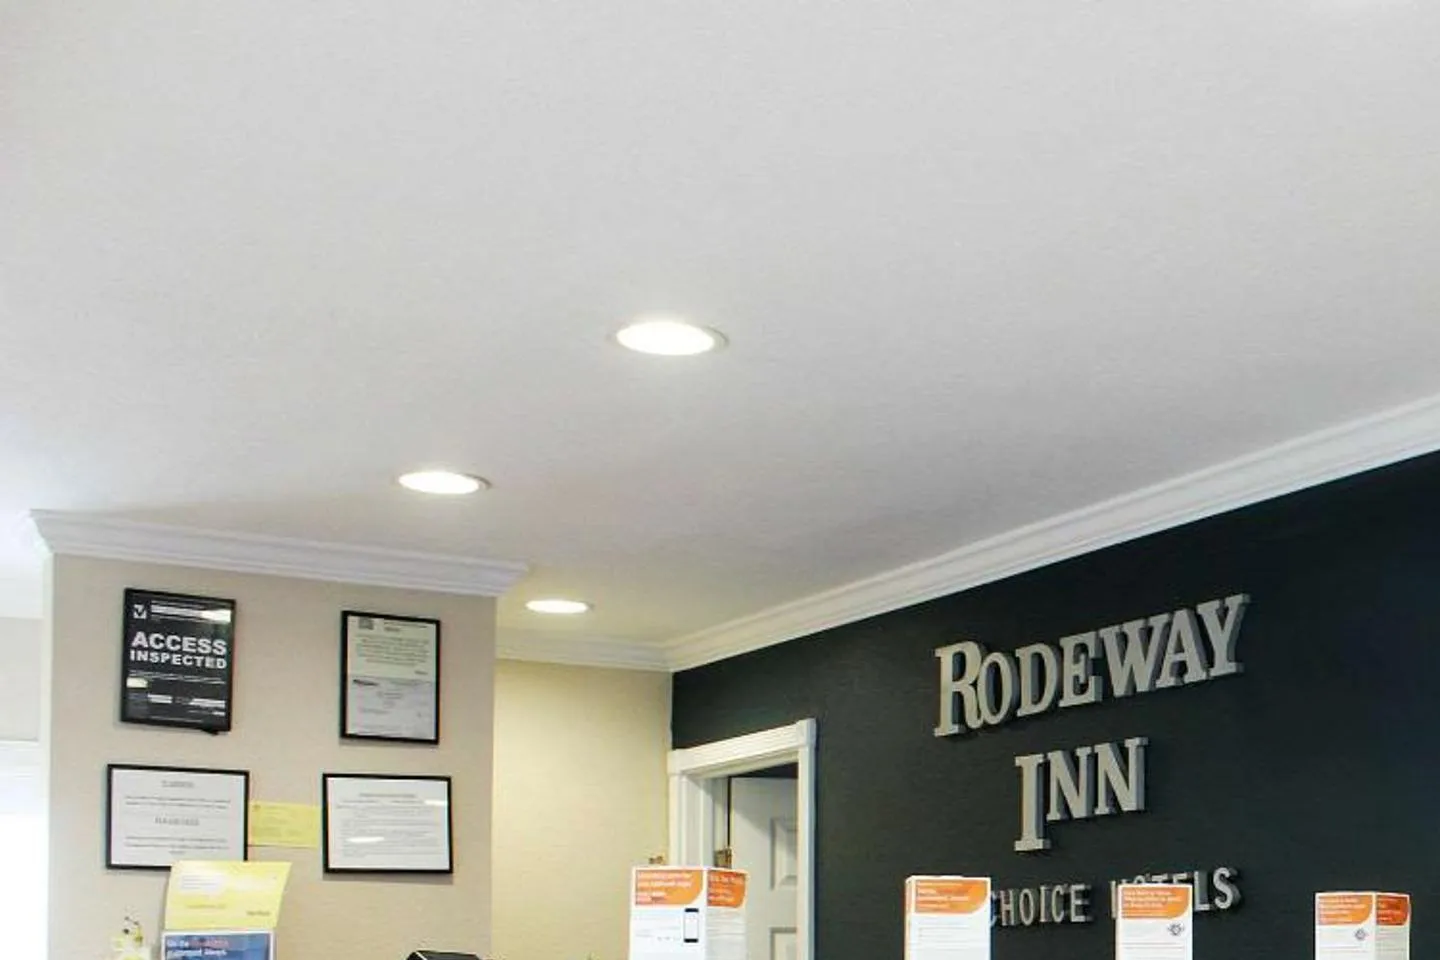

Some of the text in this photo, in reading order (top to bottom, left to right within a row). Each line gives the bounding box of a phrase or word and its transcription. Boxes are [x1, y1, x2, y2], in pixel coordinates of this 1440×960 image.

[130, 650, 227, 669] INSPECTED
[131, 631, 227, 656] ACCESS
[934, 593, 1251, 737] RODEWAY
[1014, 737, 1148, 851] INN
